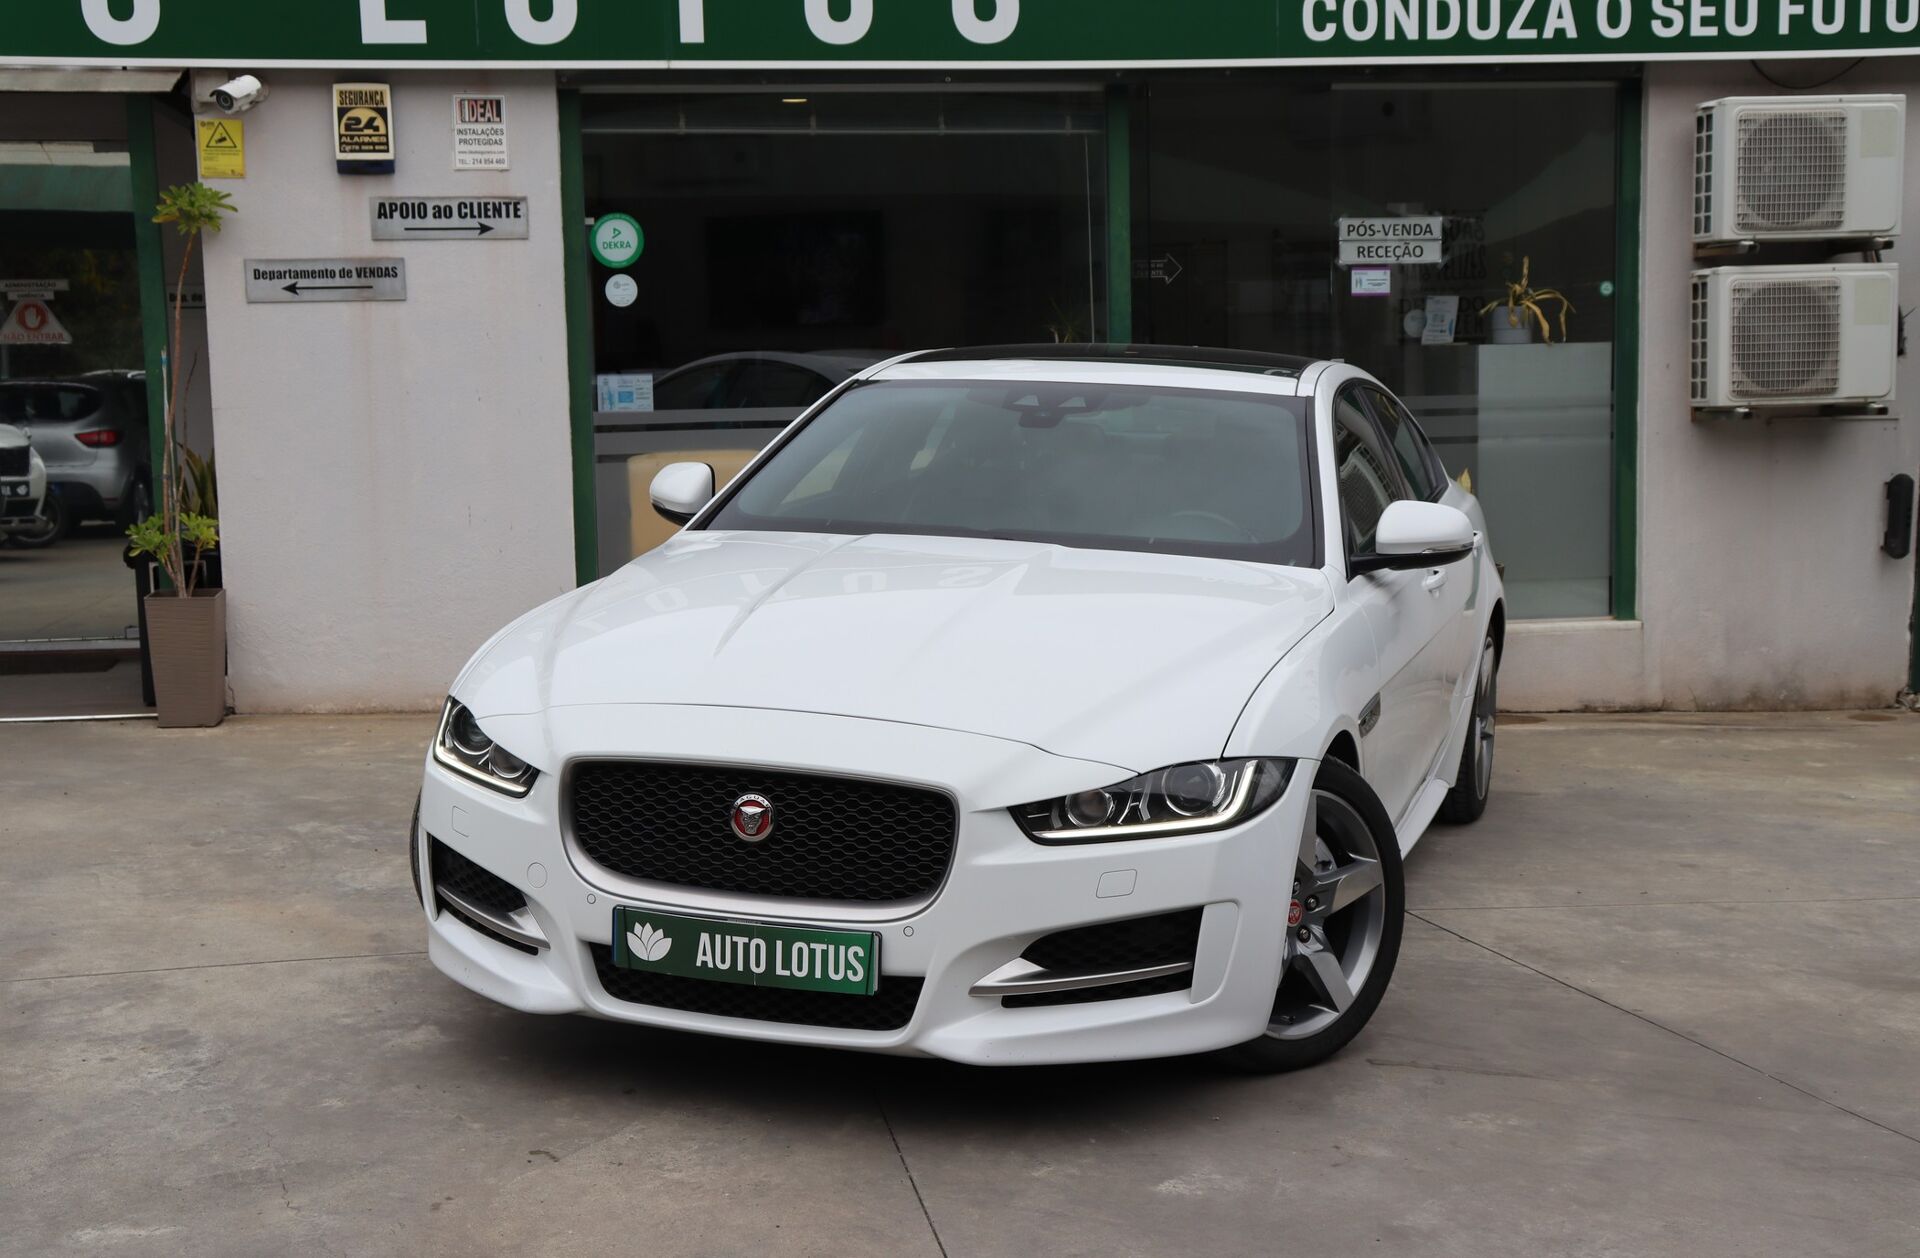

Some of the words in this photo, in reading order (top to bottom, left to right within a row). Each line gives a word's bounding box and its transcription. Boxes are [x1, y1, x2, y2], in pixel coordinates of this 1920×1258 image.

[1301, 0, 1578, 42] CONDUZA
[1596, 0, 1632, 39] O
[1650, 0, 1759, 38] SEU
[344, 116, 380, 132] 24
[456, 126, 505, 137] INSTALAÇÕES
[458, 137, 504, 146] PROTEGIDAS
[376, 201, 428, 220] APOIO
[432, 204, 453, 219] ao
[456, 201, 522, 219] CLIENTE
[1346, 220, 1435, 237] PÓS-VENDA
[602, 241, 632, 250] DEKRA
[1356, 241, 1425, 261] RECEÇÃO
[252, 267, 337, 282] Departamento
[338, 266, 354, 279] de
[355, 265, 399, 279] VENDAS
[695, 932, 767, 975] AUTO
[775, 939, 865, 982] LOTUS
